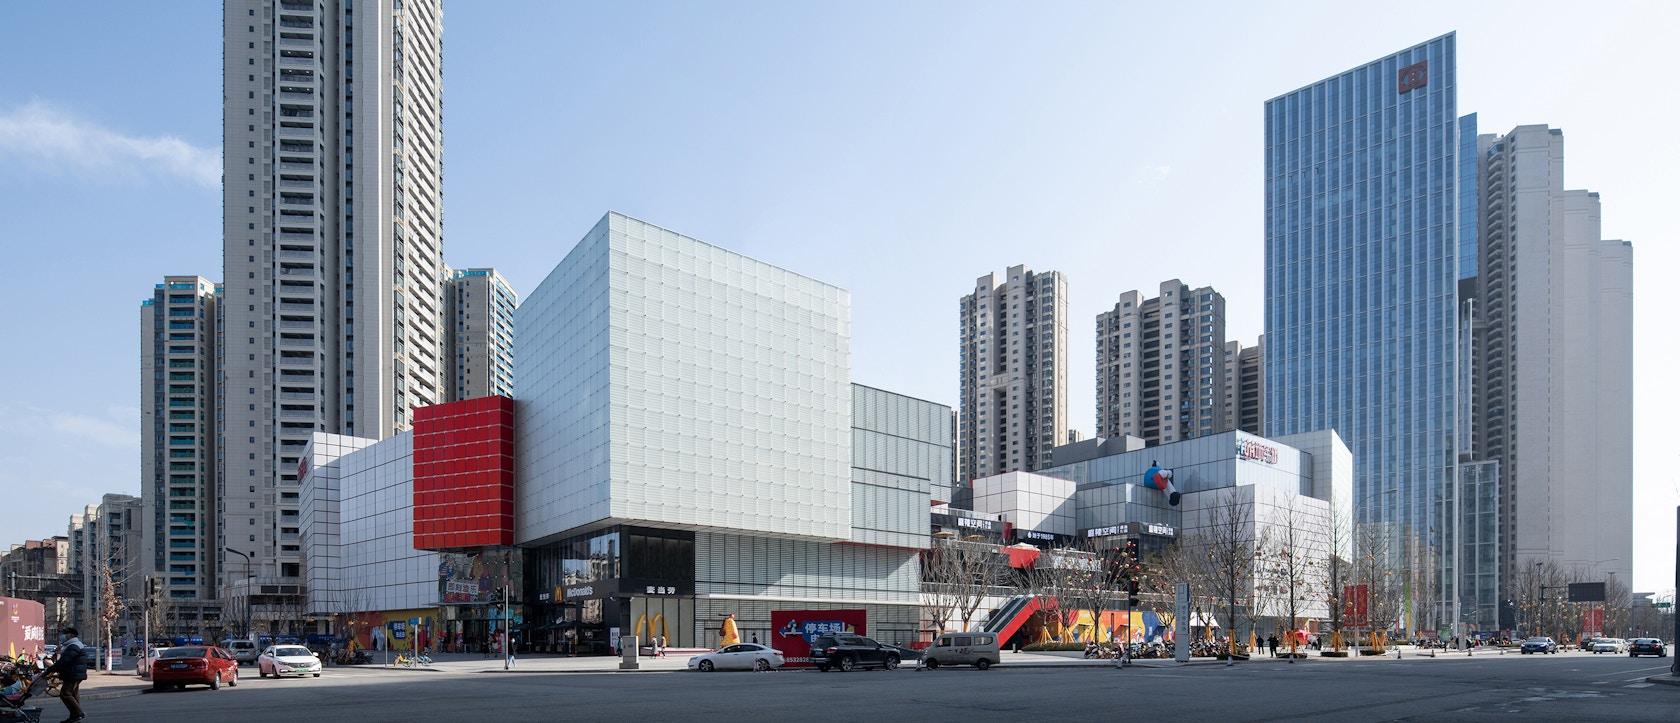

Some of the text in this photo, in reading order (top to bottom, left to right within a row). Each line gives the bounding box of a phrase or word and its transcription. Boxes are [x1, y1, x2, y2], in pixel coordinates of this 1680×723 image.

[567, 586, 593, 597] McDonald's
[646, 586, 676, 594] 麦当劳
[804, 622, 841, 634] 停车场
